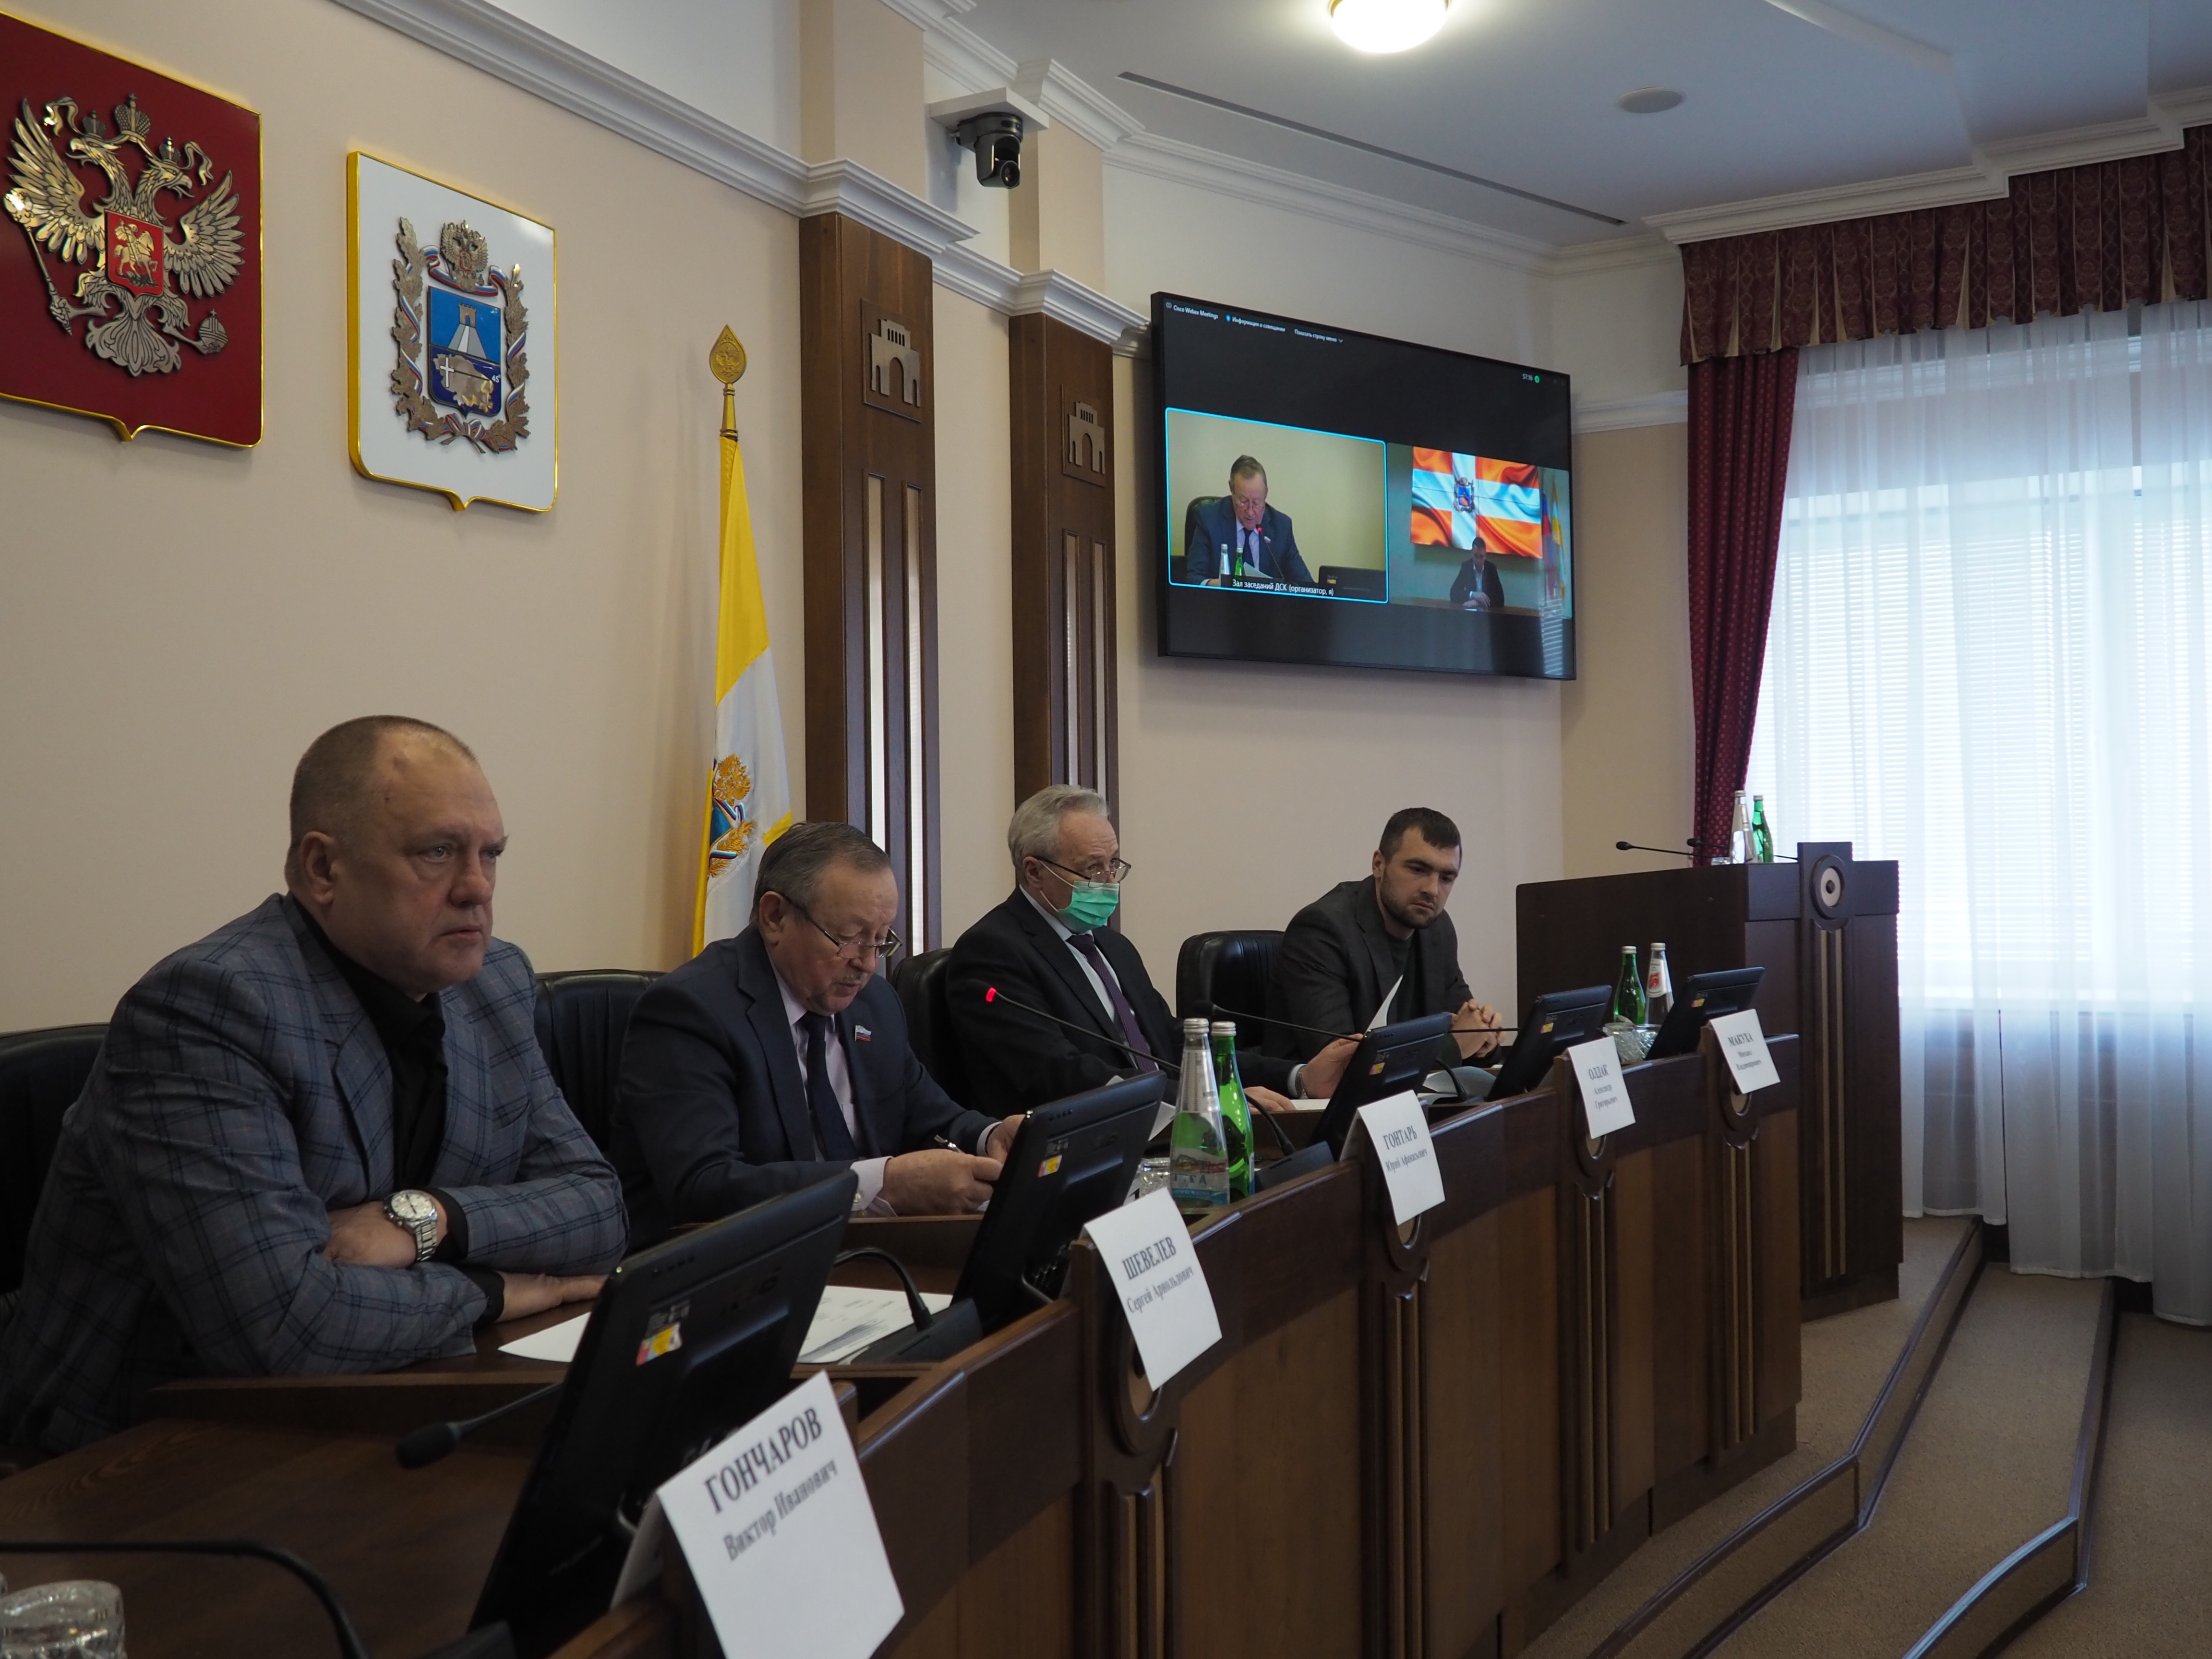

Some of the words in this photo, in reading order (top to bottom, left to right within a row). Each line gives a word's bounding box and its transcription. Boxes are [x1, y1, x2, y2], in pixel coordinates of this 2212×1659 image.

[1200, 310, 1218, 320] Meetings
[1232, 579, 1243, 587] Зал
[1244, 582, 1274, 590] заседаний
[1274, 583, 1287, 591] ДСК
[1289, 584, 1328, 596] (организатор,
[1328, 588, 1334, 596] я)
[1728, 1033, 1754, 1047] МАКУХА
[1588, 1064, 1609, 1081] ОЛДАК
[1383, 1125, 1418, 1150] ГОНТАРЬ
[1385, 1157, 1401, 1173] Юрий
[1122, 1236, 1177, 1281] ШЕВЕЛЕВ
[1127, 1287, 1154, 1313] Сергей
[1153, 1266, 1194, 1300] Арнольдович
[703, 1407, 823, 1515] ГОНЧАРОВ
[722, 1509, 778, 1563] Виктор
[773, 1459, 839, 1521] Иванович
